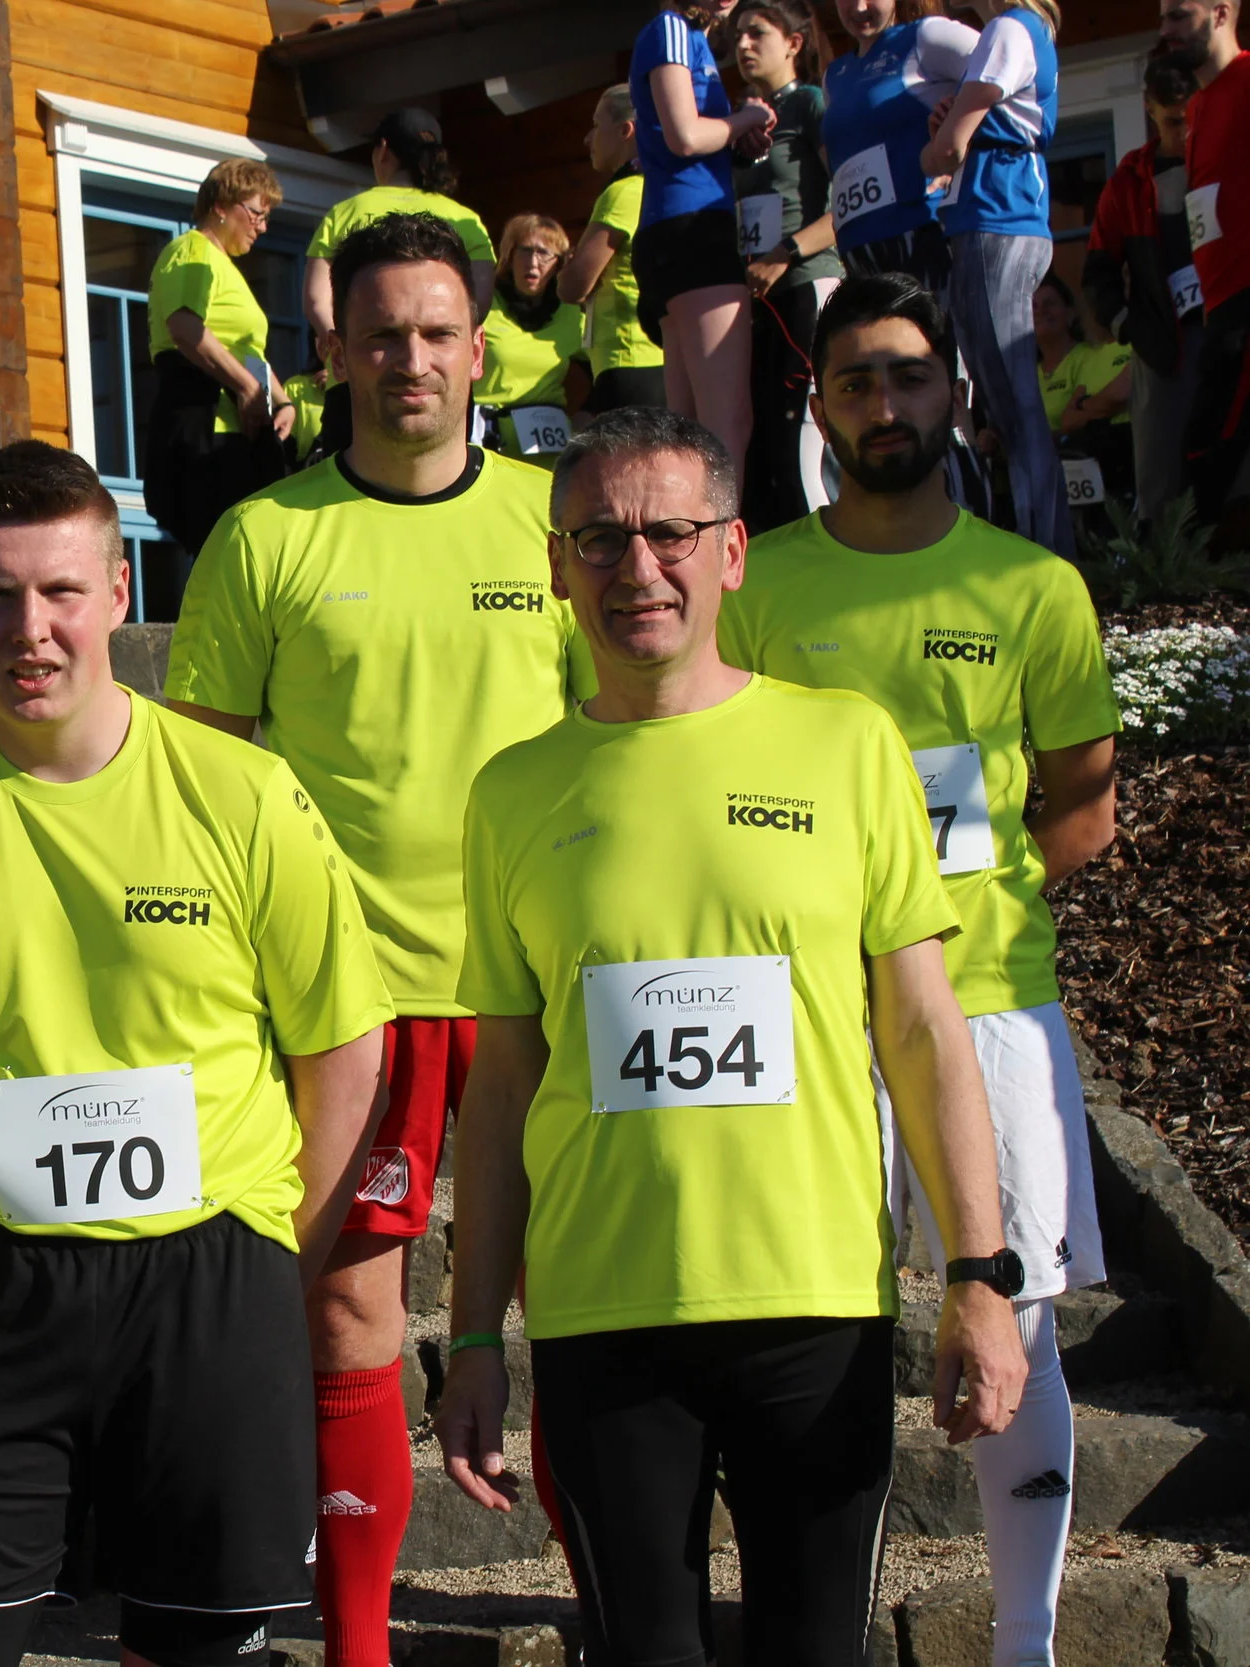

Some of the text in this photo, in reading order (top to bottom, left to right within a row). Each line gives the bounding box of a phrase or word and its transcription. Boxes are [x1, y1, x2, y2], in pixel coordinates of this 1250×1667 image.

[837, 176, 882, 219] 356
[530, 427, 568, 448] 163
[481, 581, 544, 591] INTERSPORT
[338, 591, 368, 602] JAKO
[472, 592, 544, 613] KOCH
[934, 628, 999, 643] INTERSPORT
[808, 643, 840, 652] JAKO
[923, 640, 997, 666] KOCH
[739, 793, 816, 810] INTERSPORT
[727, 805, 814, 834] KOCH
[567, 826, 598, 846] JAKO
[137, 886, 213, 899] INTERSPORT
[124, 899, 211, 926] KOCH
[677, 1003, 736, 1013] teamkleidung
[620, 1024, 765, 1092] 454
[84, 1116, 142, 1128] teamkleidung
[35, 1136, 165, 1207] 170
